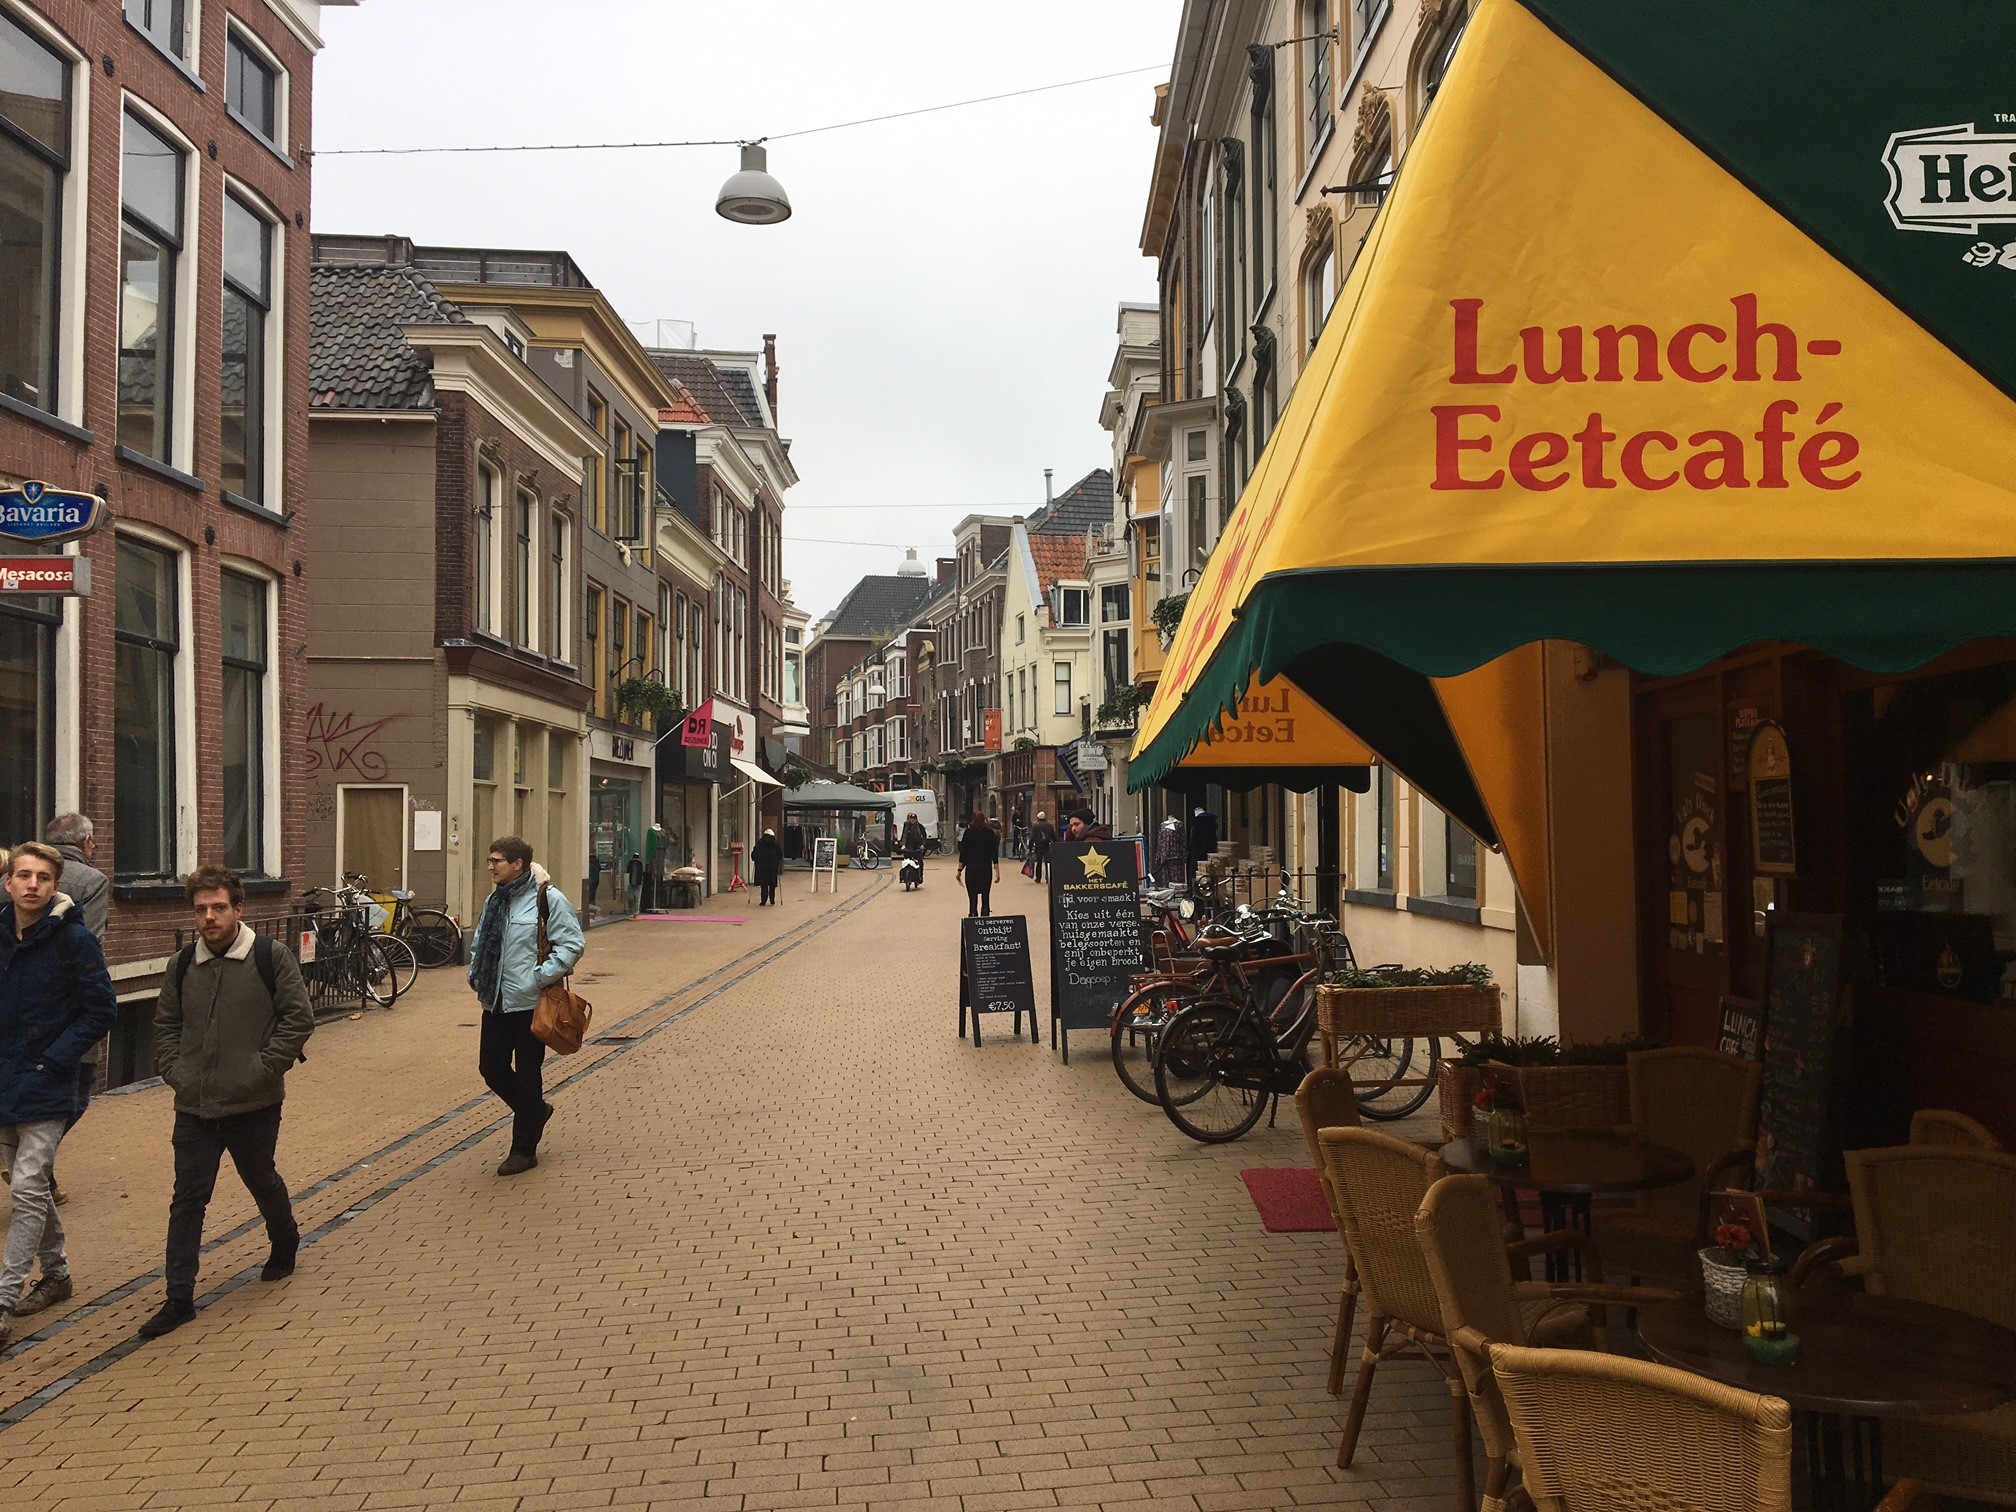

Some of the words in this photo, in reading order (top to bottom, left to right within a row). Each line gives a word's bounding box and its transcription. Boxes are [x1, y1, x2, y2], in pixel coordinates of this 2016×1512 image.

[1993, 114, 2016, 123] TRA
[1449, 292, 1842, 384] Lunch-
[1430, 399, 1862, 491] Eetcafé
[1063, 881, 1129, 891] BAKKERSCAFÉ
[1101, 891, 1136, 903] smaak!
[1066, 910, 1090, 920] Kies
[1094, 910, 1111, 918] uit
[1115, 909, 1135, 918] één
[978, 926, 1012, 935] Ontbijt!
[1058, 922, 1078, 930] van
[1081, 921, 1105, 929] onze
[1061, 928, 1139, 941] huisgemaakte
[973, 942, 1021, 952] Breakfast!
[1059, 938, 1125, 950] belegsoorten
[1064, 948, 1084, 960] snij
[1064, 957, 1077, 972] je
[1079, 957, 1108, 970] eigen
[1111, 954, 1143, 966] brood!
